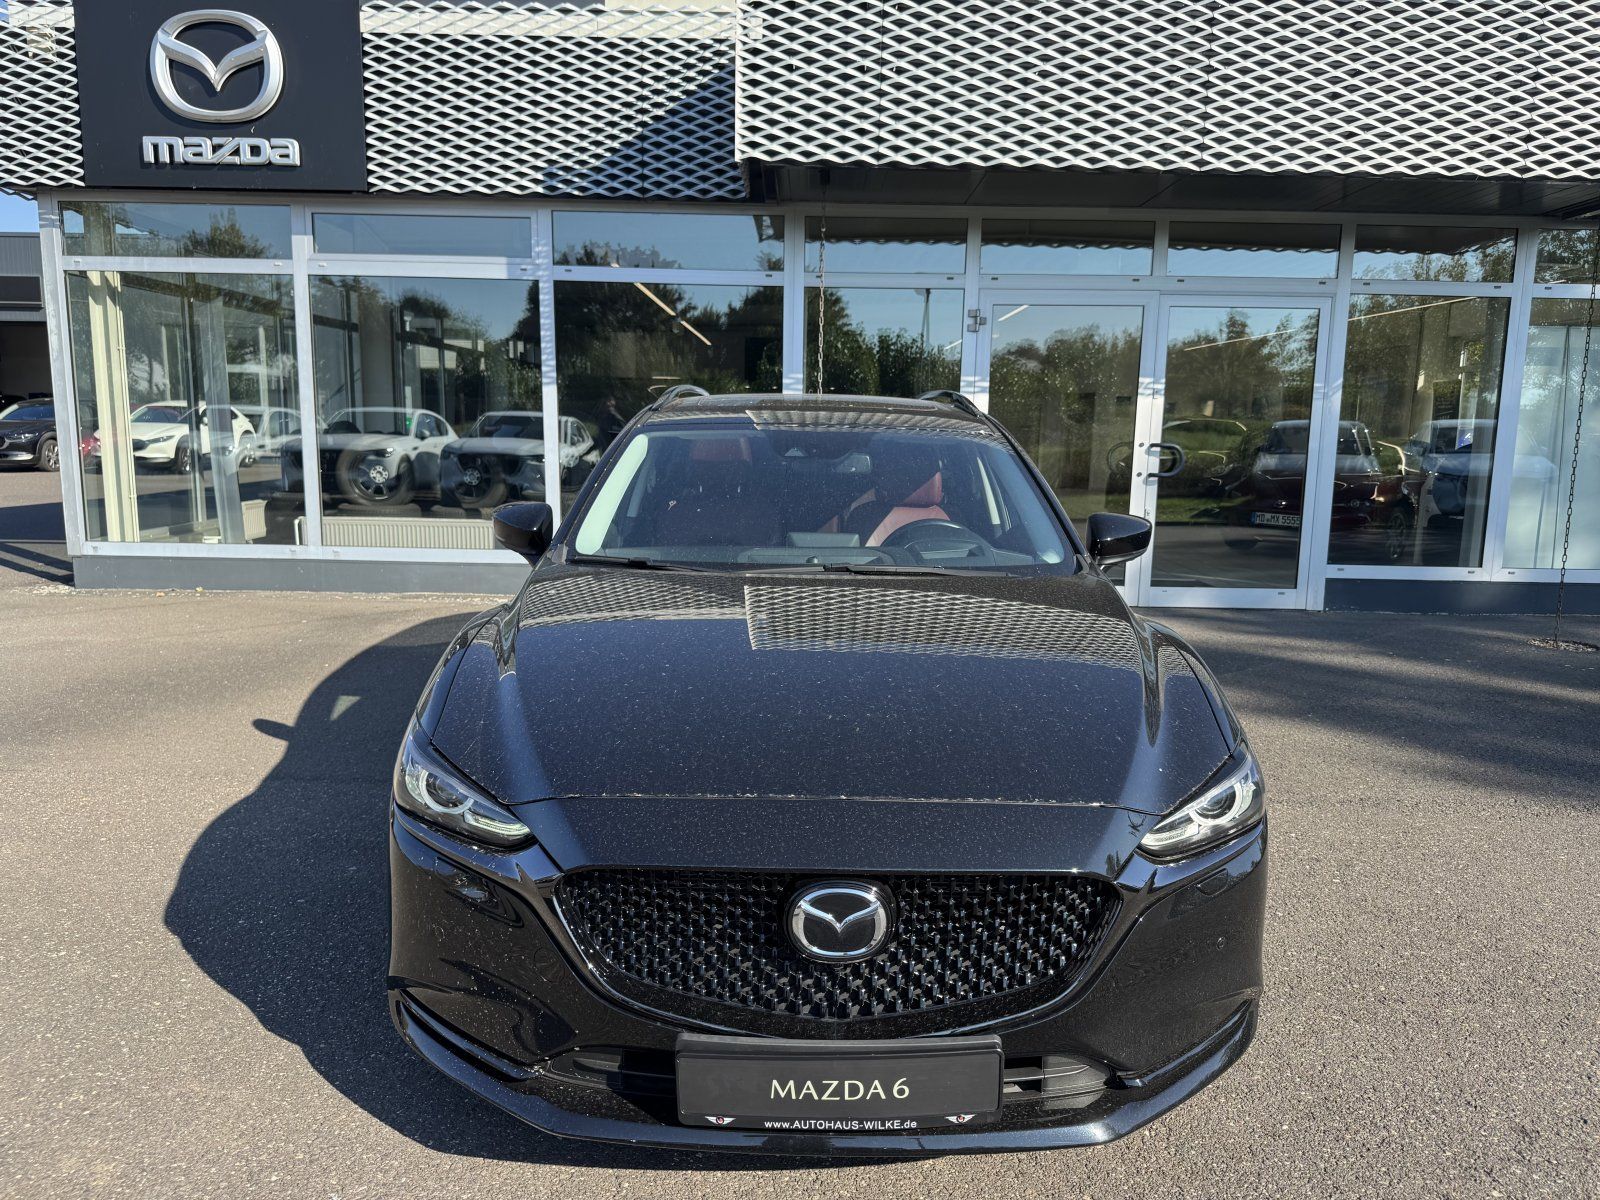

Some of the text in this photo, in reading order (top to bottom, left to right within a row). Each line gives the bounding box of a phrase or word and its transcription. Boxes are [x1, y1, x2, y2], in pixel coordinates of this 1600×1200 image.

[1270, 515, 1280, 524] MX
[770, 1077, 910, 1101] MAZDA 6
[764, 1119, 918, 1130] www.AUTOHAUS-WILKE.de
